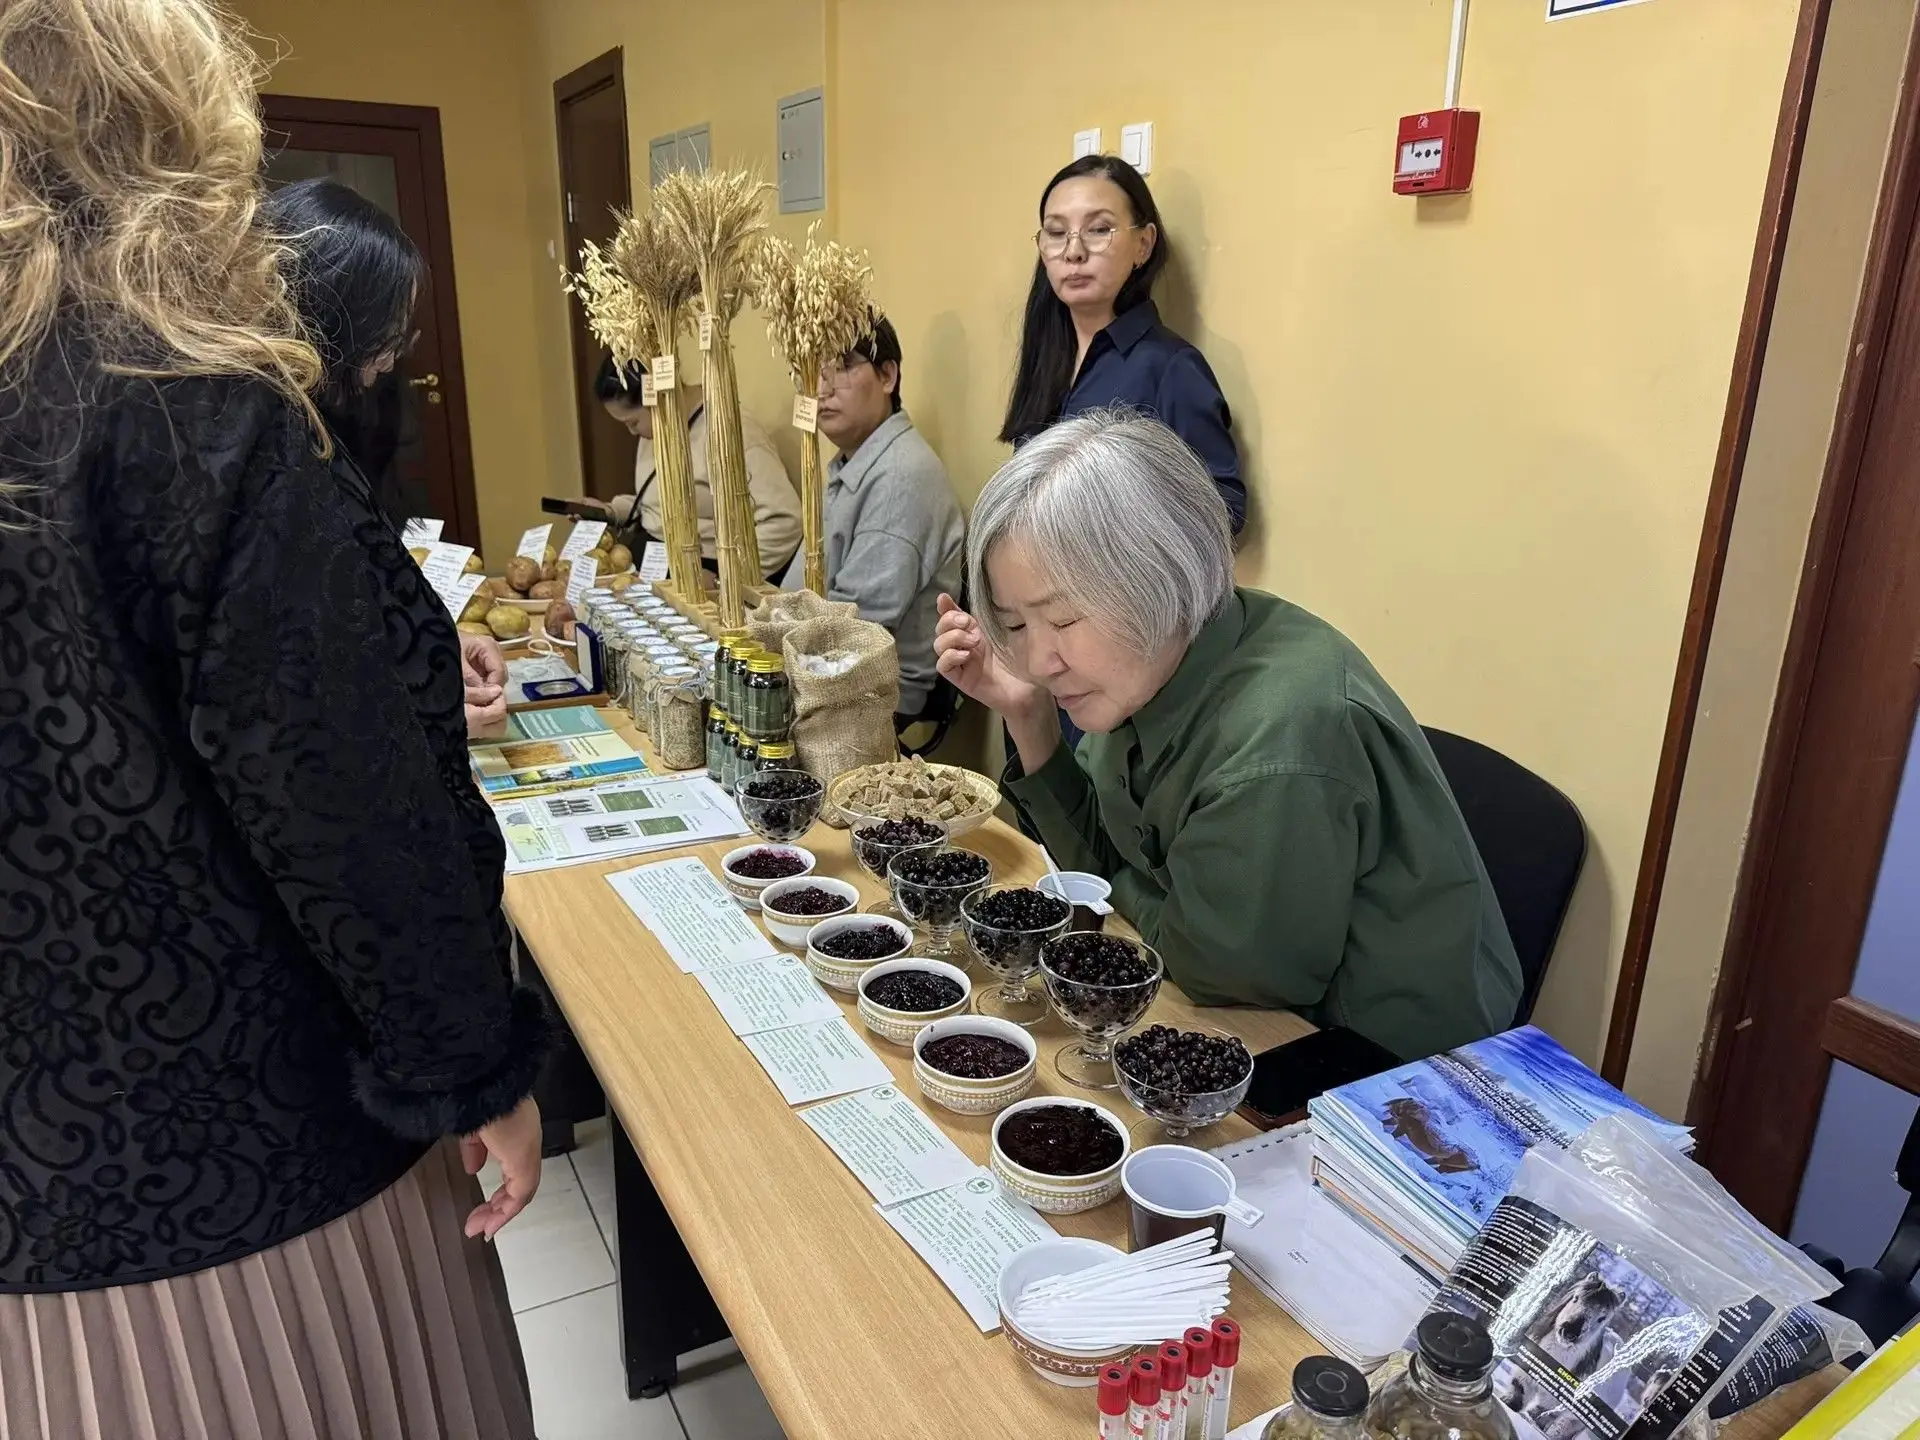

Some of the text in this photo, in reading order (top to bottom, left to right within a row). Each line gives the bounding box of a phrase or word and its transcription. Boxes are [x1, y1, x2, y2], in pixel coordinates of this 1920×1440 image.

[1452, 1060, 1495, 1097] КОРМОВОЙ
[1492, 1093, 1532, 1127] ДОБАВКИ
[1459, 1073, 1504, 1112] ТАБУННОГО
[1501, 1108, 1543, 1143] СОДЕРЖА
[1471, 1066, 1521, 1110] ТЕХНОЛОГИЯ
[1517, 1343, 1584, 1402] Кормолекарственн
